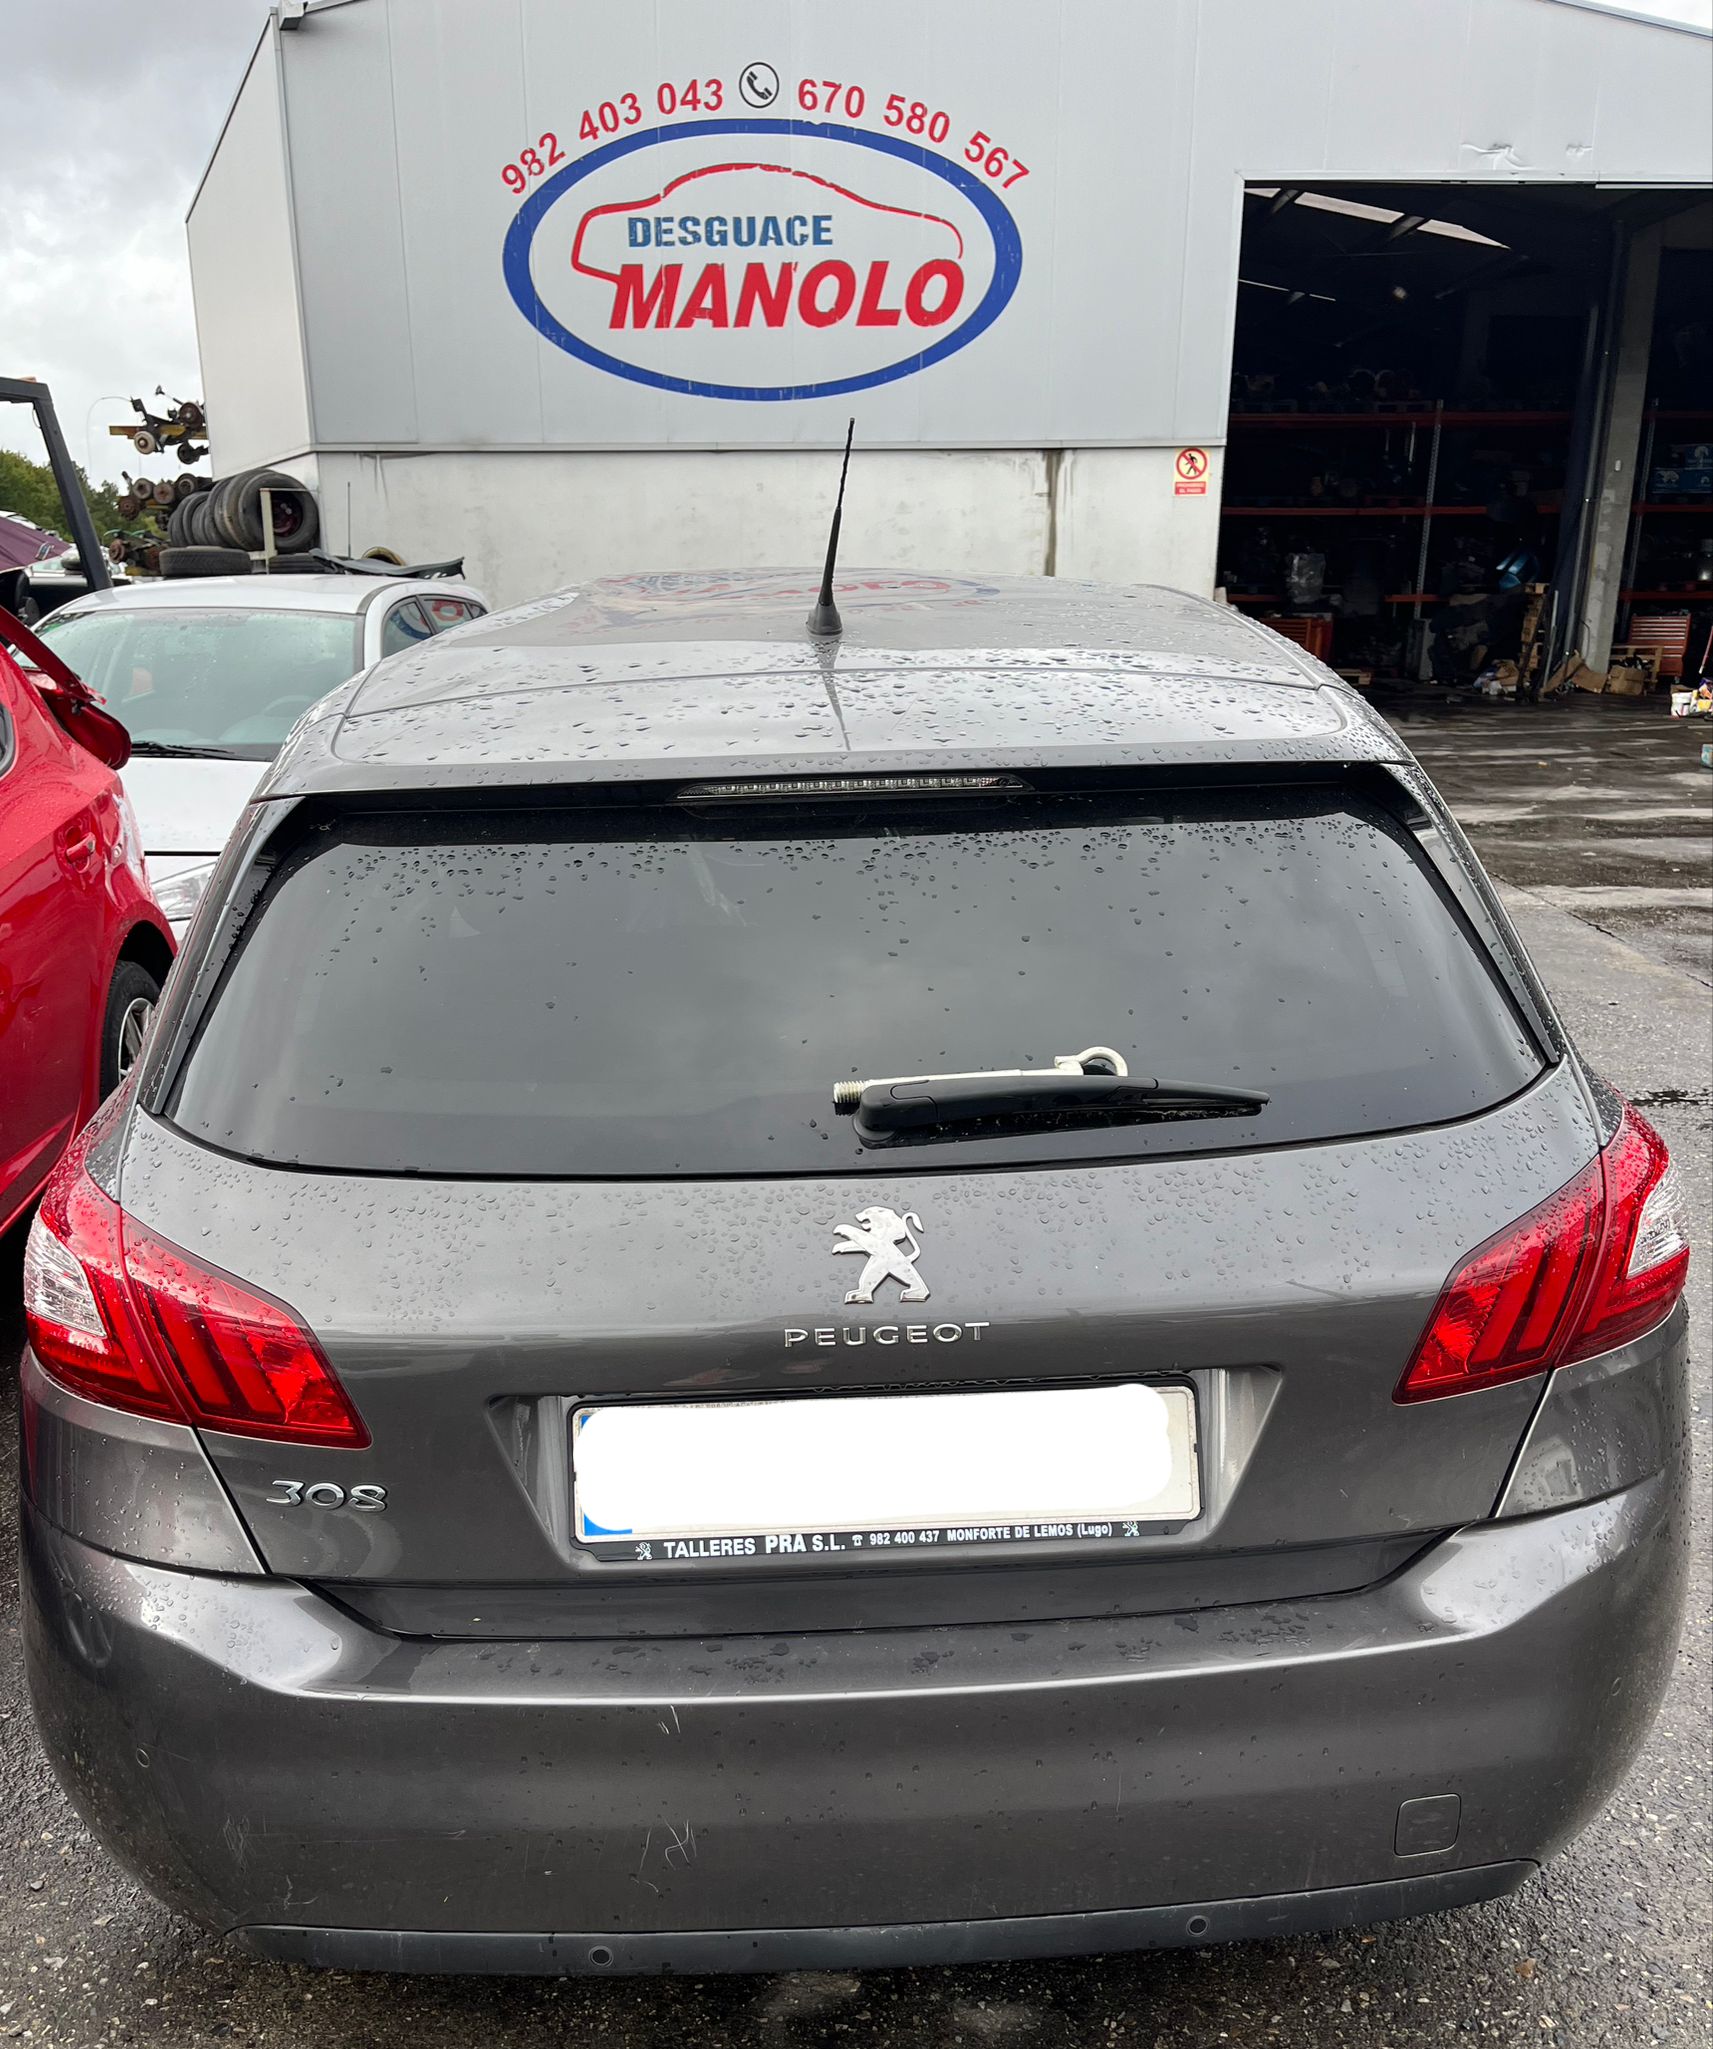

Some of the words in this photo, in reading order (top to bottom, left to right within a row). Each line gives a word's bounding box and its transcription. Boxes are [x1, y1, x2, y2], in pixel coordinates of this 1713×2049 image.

[501, 132, 567, 195] 982
[578, 92, 643, 142] 403
[657, 79, 724, 116] 043
[798, 79, 866, 119] 670
[883, 94, 951, 145] 580
[964, 131, 1030, 190] 567
[628, 215, 833, 249] DESGUACE
[608, 259, 965, 330] MANOLO
[784, 1321, 991, 1348] PEUGEOT
[266, 1480, 388, 1513] 308
[663, 1539, 757, 1559] TALLERES
[765, 1534, 808, 1555] PRA
[812, 1533, 847, 1553] S.L.
[869, 1531, 892, 1546] 982
[894, 1530, 916, 1545] 400
[918, 1529, 941, 1544] 437
[946, 1525, 1011, 1542] MONFORTE
[1014, 1525, 1031, 1539] DE
[1034, 1523, 1074, 1538] LEMOS
[1076, 1522, 1113, 1539] (Lugo)
